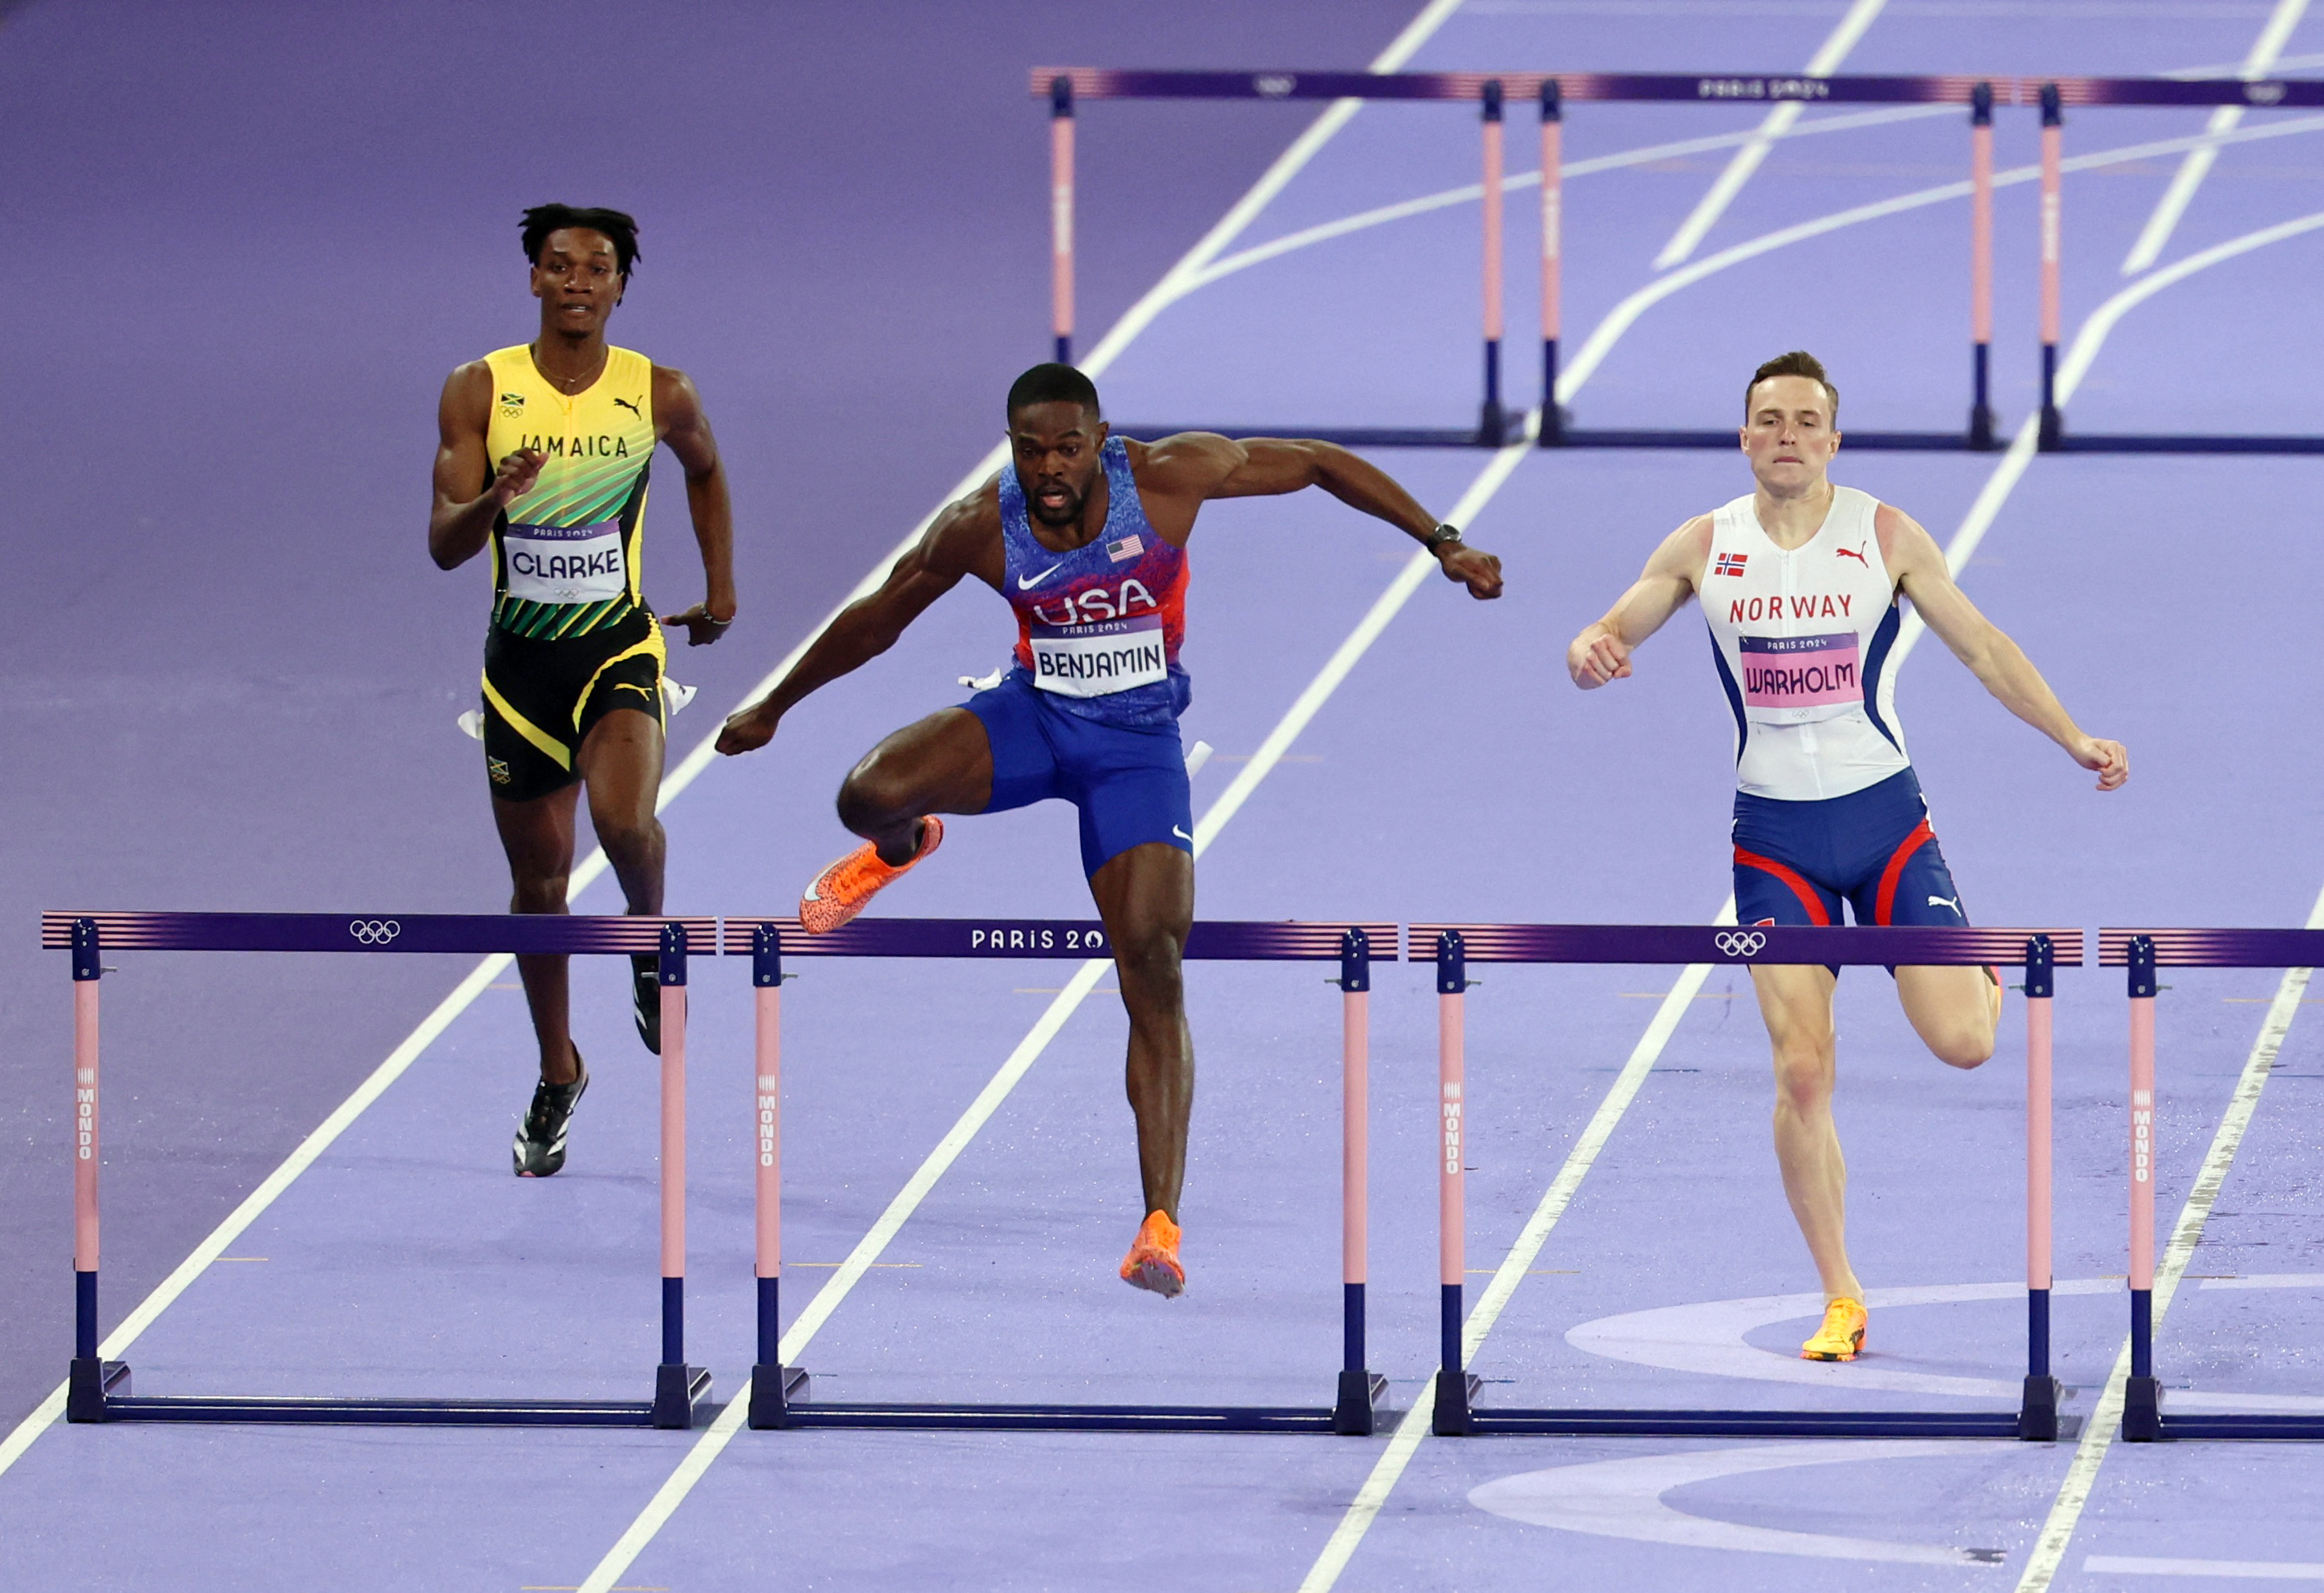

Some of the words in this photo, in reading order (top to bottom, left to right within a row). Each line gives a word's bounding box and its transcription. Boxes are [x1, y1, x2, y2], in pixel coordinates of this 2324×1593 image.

[566, 529, 593, 537] 2024
[512, 548, 620, 579] CLARKE
[1034, 578, 1157, 626] USA
[1730, 594, 1851, 623] NORWAY
[1063, 626, 1095, 634] PARIS
[1098, 622, 1128, 632] 2024
[1767, 641, 1796, 651] PARIS
[1800, 639, 1827, 649] 2024
[1039, 644, 1161, 679] BENJAMIN
[1746, 663, 1855, 695] WARHOLM
[1066, 930, 1112, 949] 20
[77, 1088, 94, 1160] MONDO
[758, 1096, 775, 1167] MONDO
[1443, 1103, 1460, 1174] MONDO
[2133, 1110, 2151, 1182] MONDO
